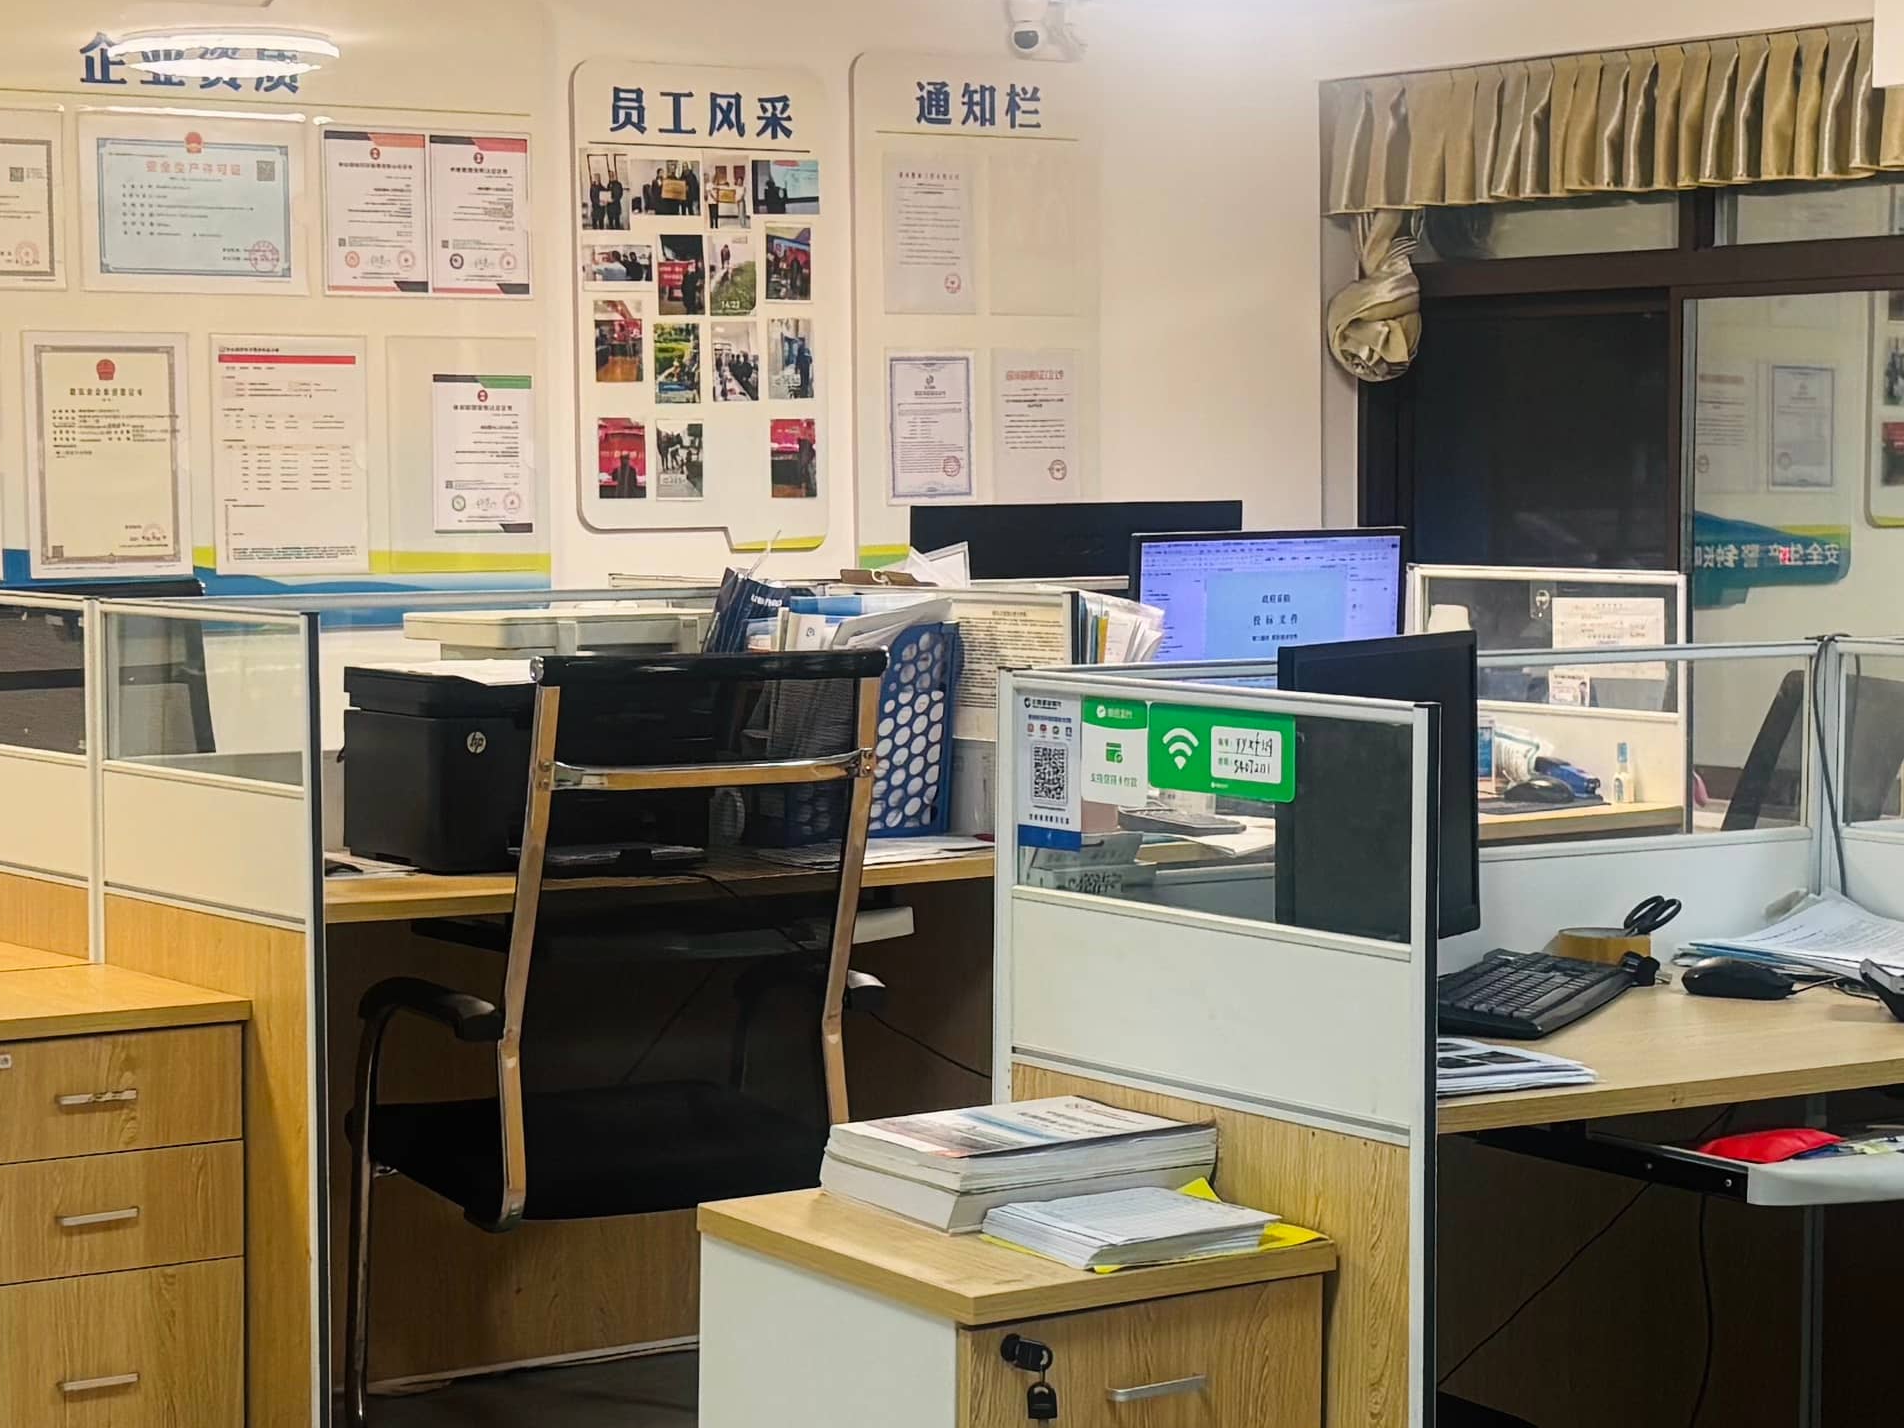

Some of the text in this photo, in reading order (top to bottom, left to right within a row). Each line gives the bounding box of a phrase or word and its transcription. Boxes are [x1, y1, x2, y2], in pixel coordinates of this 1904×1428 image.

[609, 86, 794, 140] 员工风采
[914, 80, 1043, 129] 通知栏
